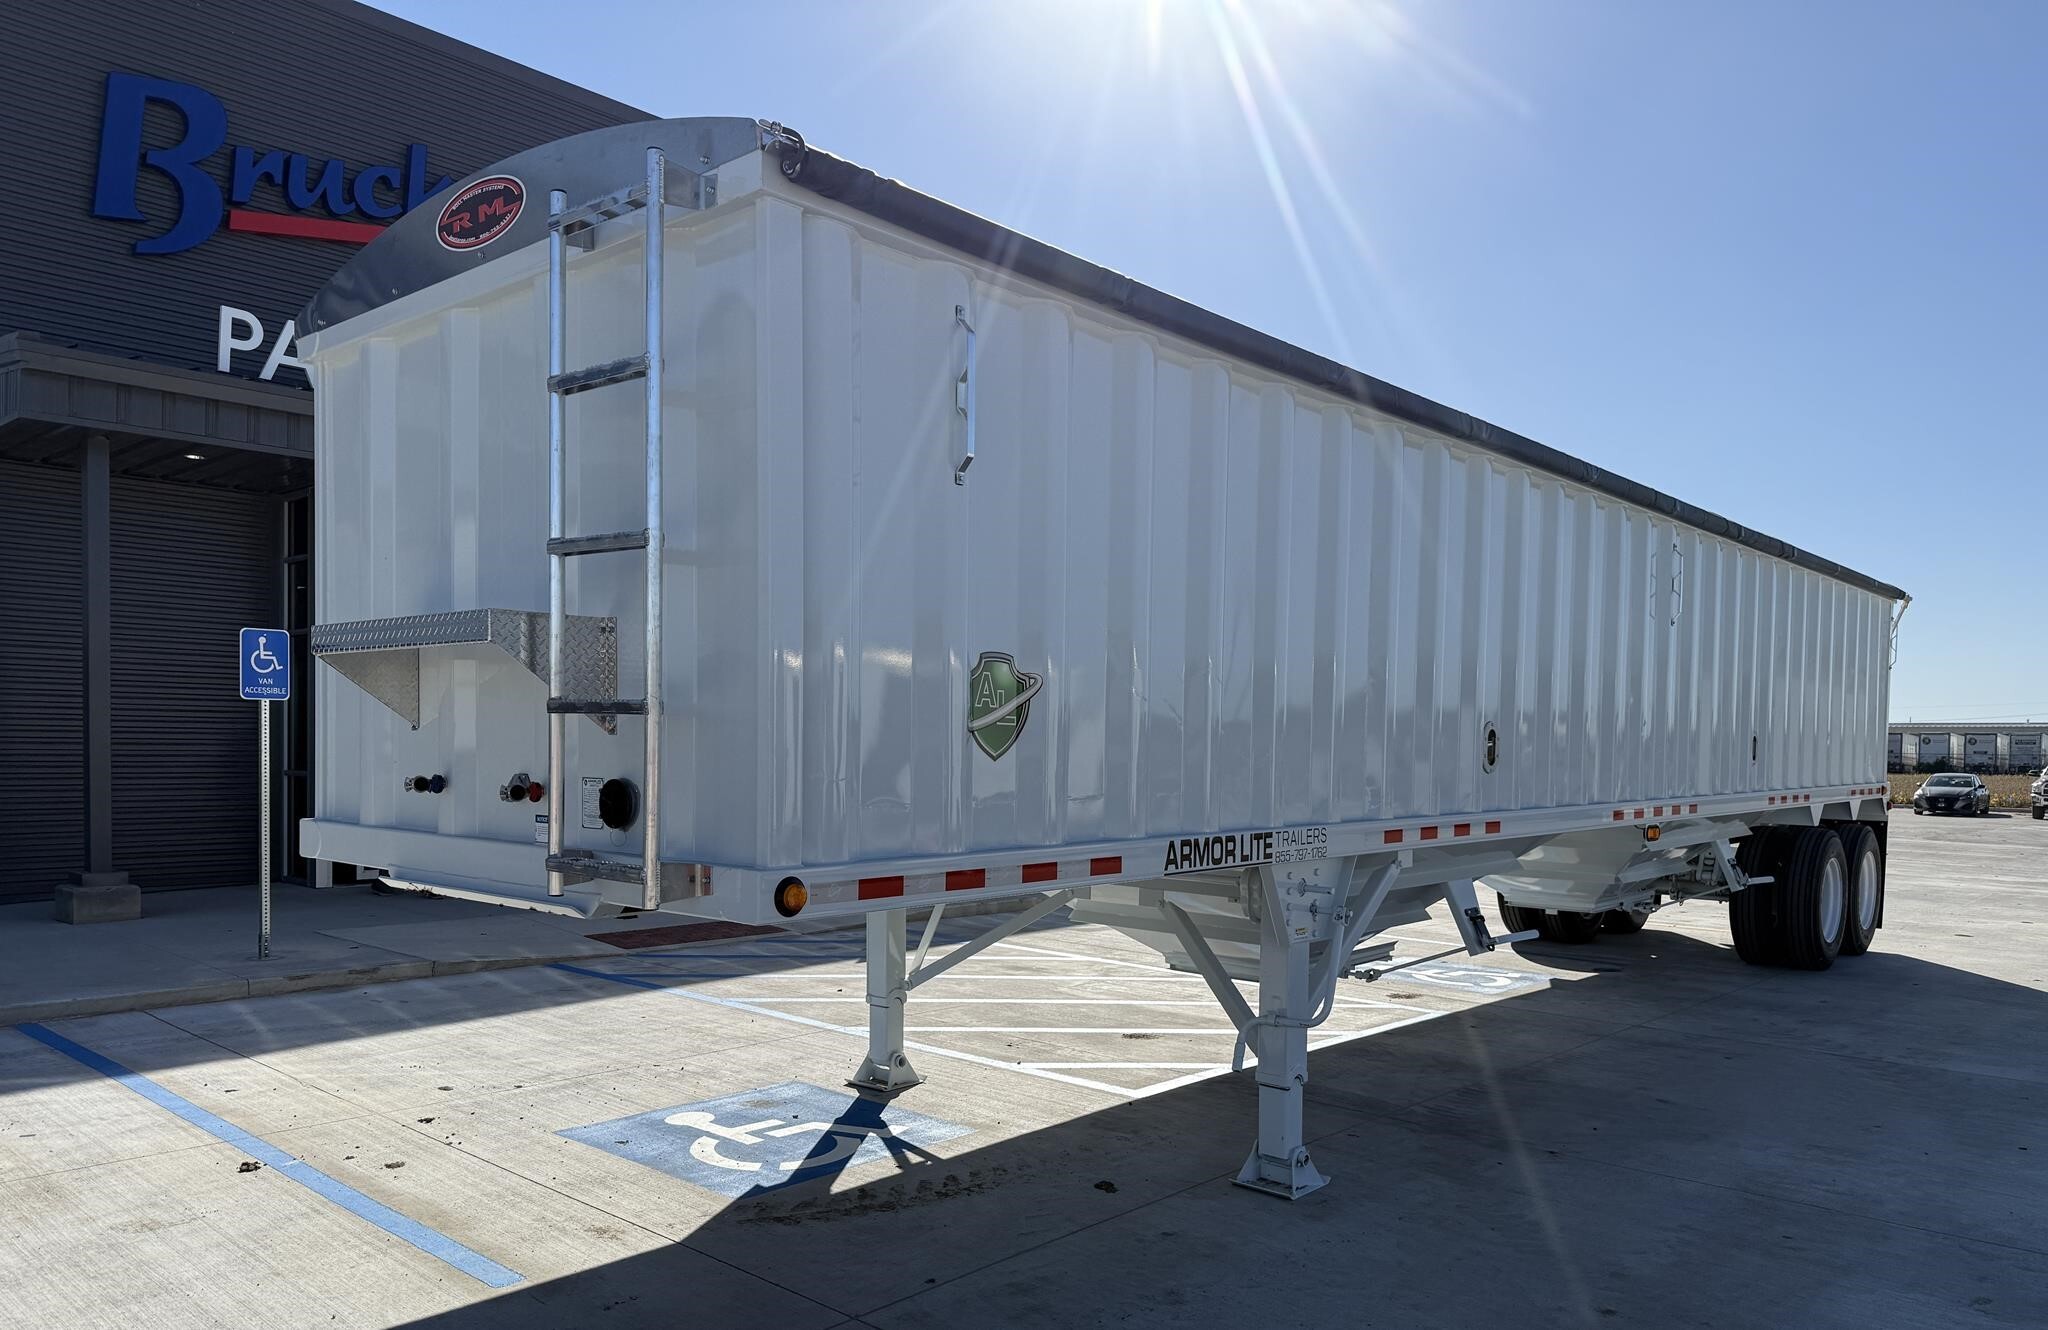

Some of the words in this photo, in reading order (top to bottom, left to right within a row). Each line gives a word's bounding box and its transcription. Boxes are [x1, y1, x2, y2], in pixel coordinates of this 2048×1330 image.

[463, 188, 482, 201] MASTER
[482, 185, 505, 193] SYSTEMS
[258, 677, 273, 685] VAN
[244, 686, 287, 695] ACCESSIBLE
[1275, 827, 1328, 848] TRAILERS
[1164, 835, 1236, 871] ARMOR
[1240, 832, 1273, 862] LITE
[1275, 846, 1328, 864] 855-797-1762
